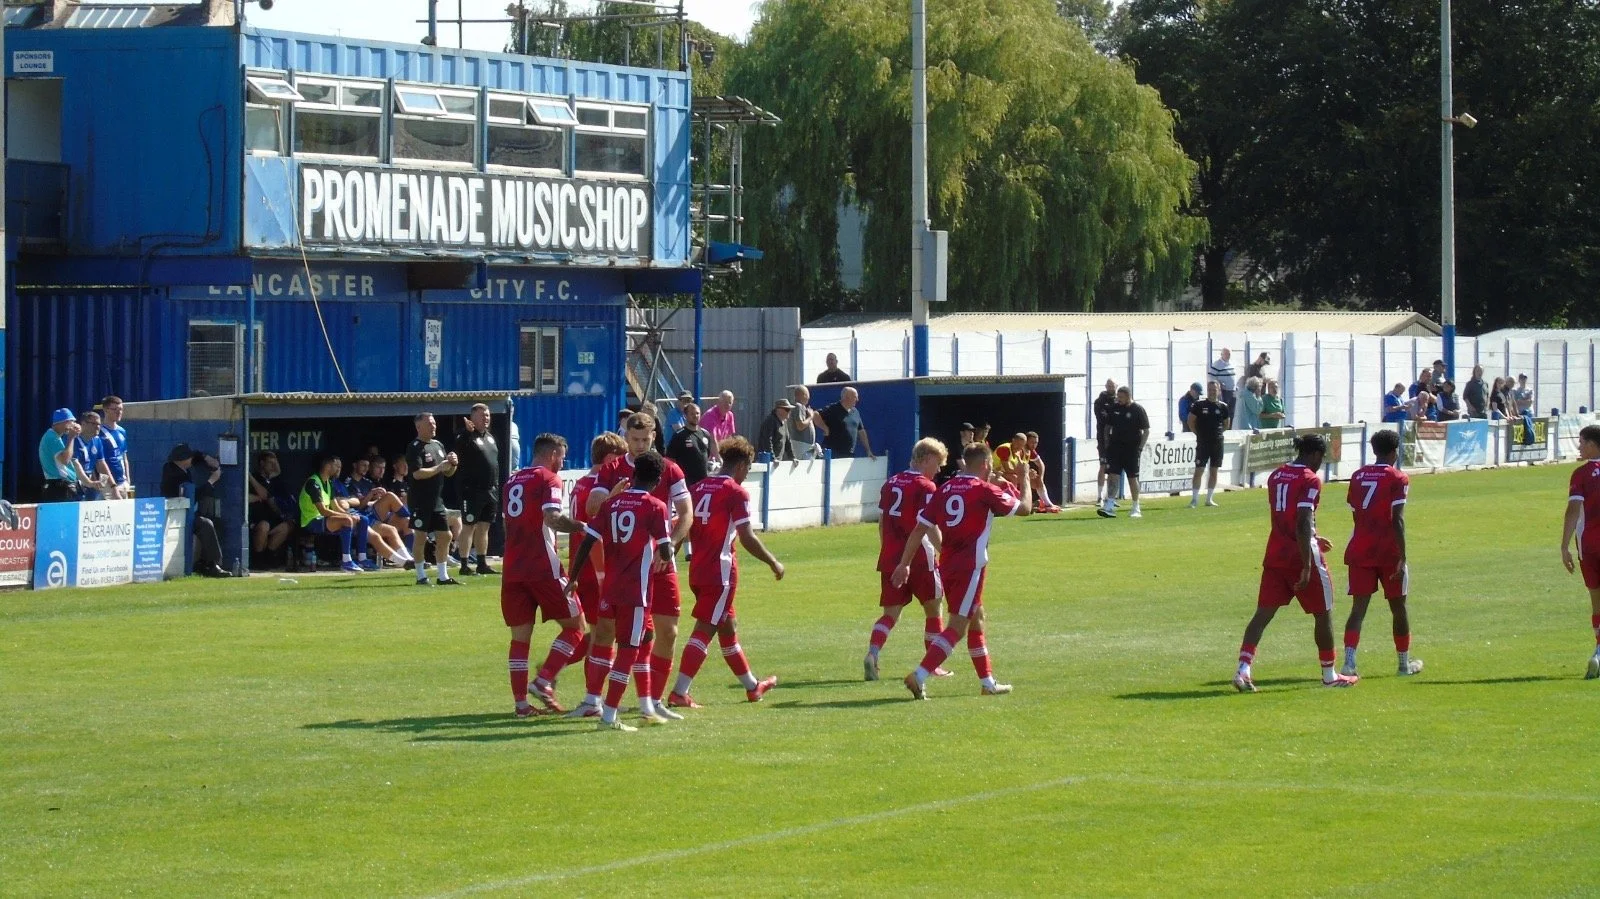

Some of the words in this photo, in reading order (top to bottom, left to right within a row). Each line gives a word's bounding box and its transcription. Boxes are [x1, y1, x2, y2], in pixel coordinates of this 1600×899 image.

[303, 168, 485, 246] PROMENADE
[287, 431, 322, 451] CITY
[1153, 442, 1196, 465] Stento
[507, 484, 524, 518] 8
[694, 493, 713, 525] 4
[888, 486, 903, 517] 2
[945, 494, 965, 527] 9
[1275, 483, 1289, 512] 11
[1360, 480, 1378, 510] 7
[82, 522, 131, 539] ENGRAVING
[611, 510, 636, 544] 19
